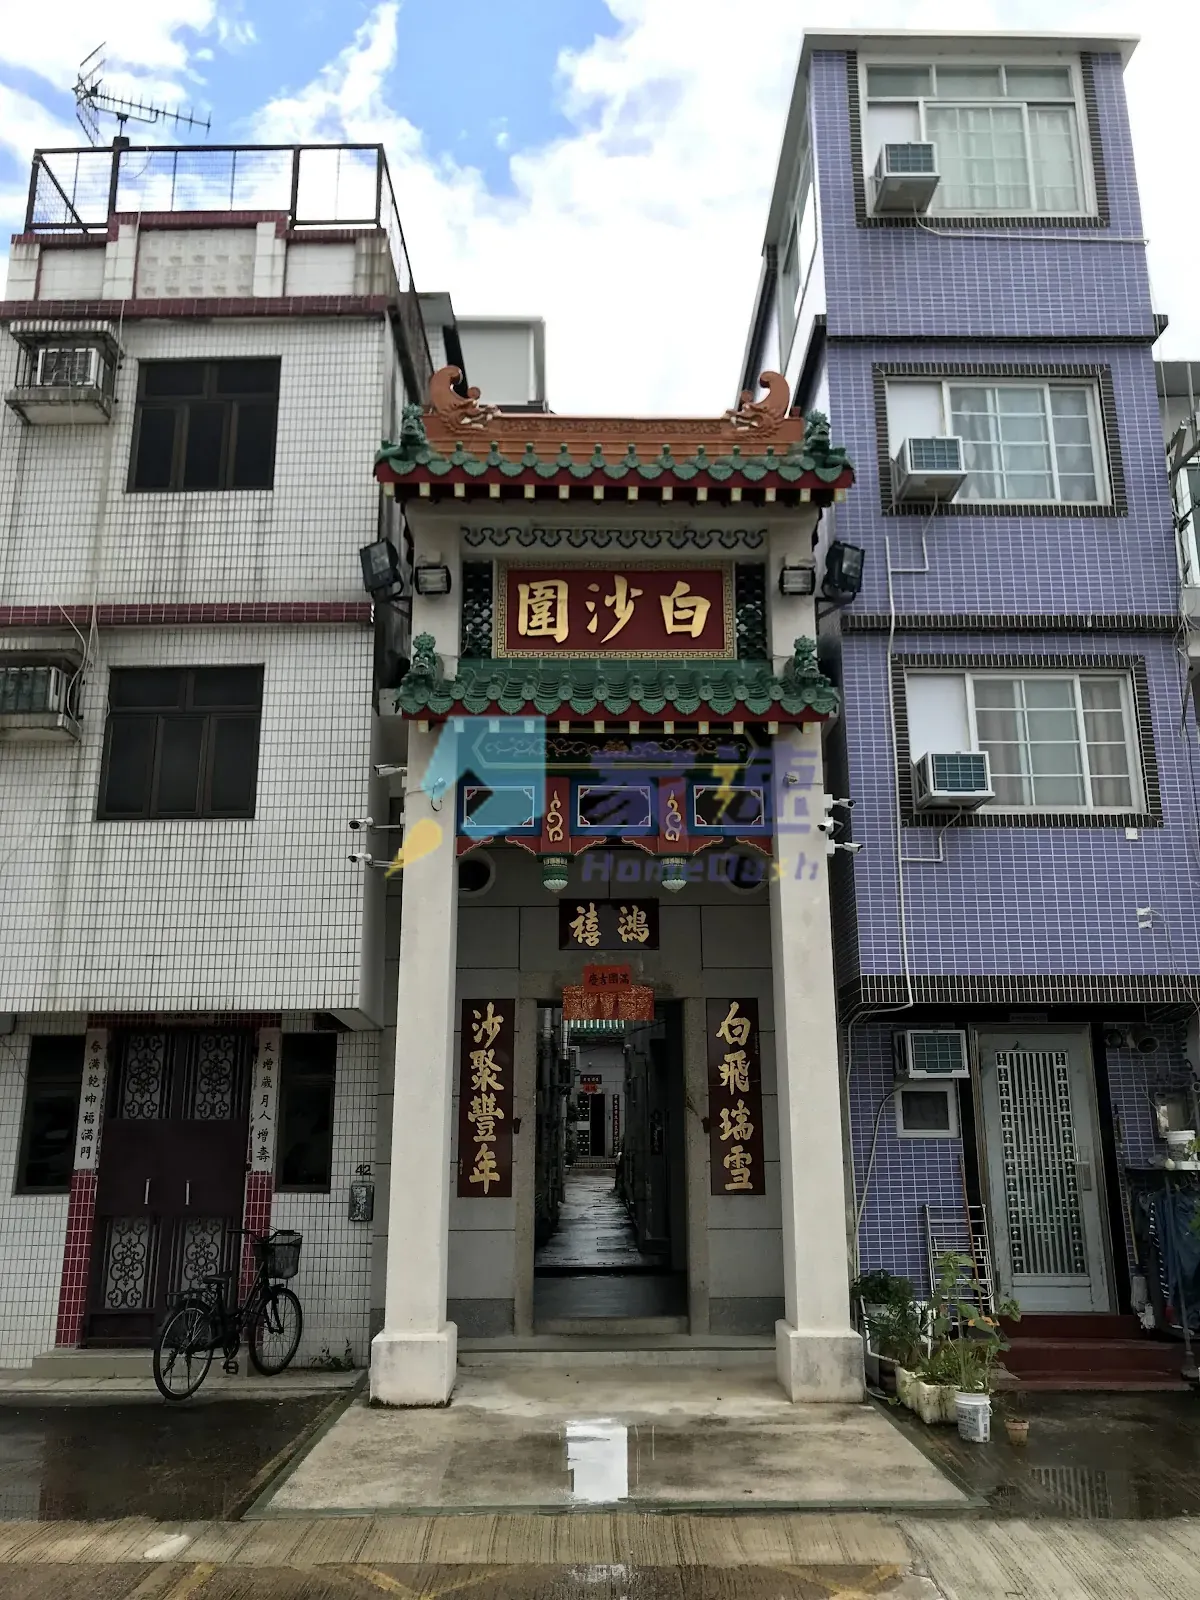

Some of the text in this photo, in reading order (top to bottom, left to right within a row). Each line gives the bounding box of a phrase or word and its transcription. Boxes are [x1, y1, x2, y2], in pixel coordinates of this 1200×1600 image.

[517, 574, 712, 644] 白沙圍
[568, 902, 650, 947] 鴻禧
[80, 1040, 102, 1160] 春滿乾坤福滿門
[256, 1042, 275, 1162] 天增歲月人增壽
[468, 1001, 505, 1195] 沙聚豐年
[715, 1001, 755, 1191] 白飛瑞雪
[355, 1164, 372, 1176] 42
